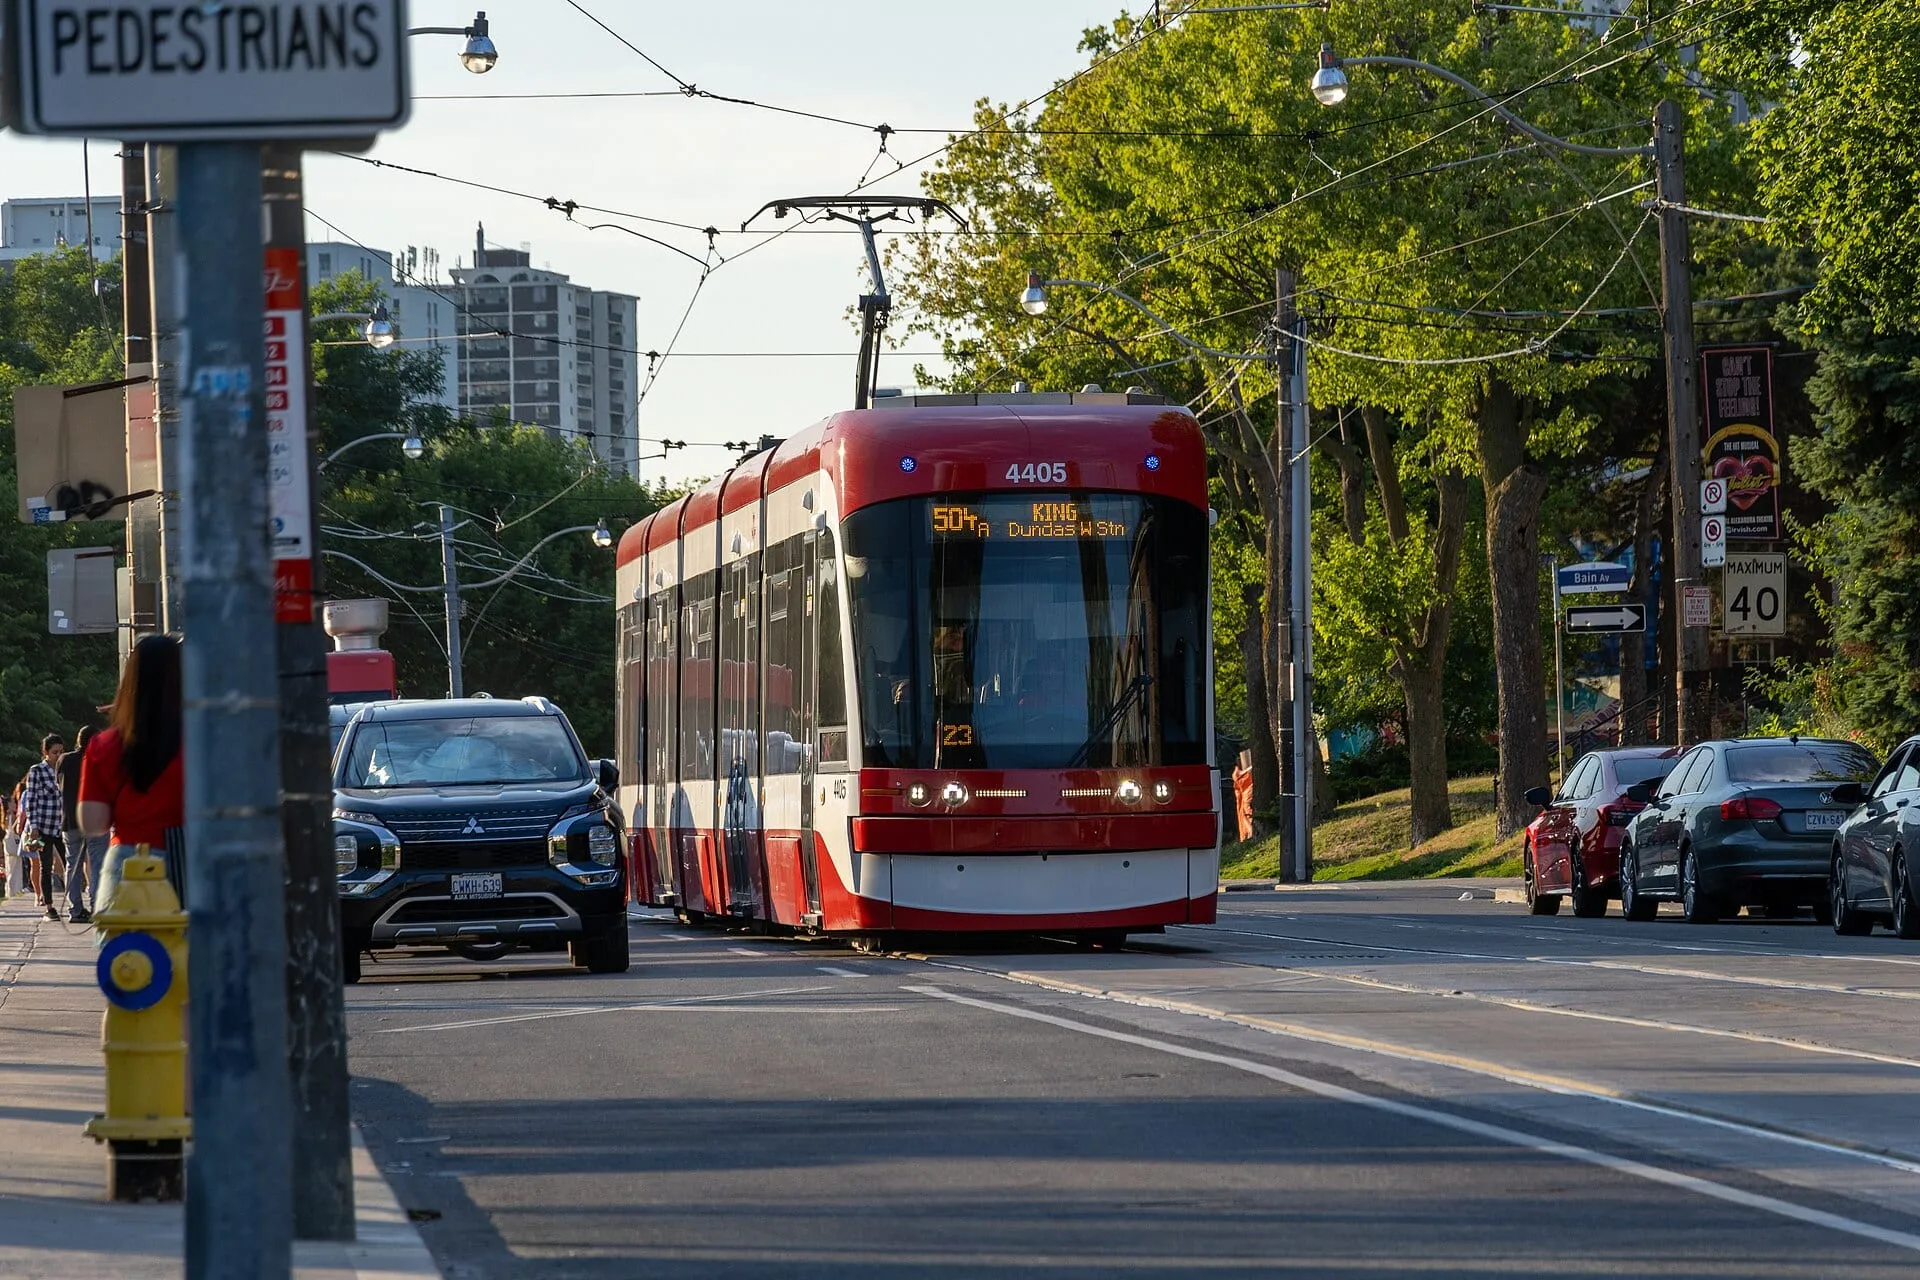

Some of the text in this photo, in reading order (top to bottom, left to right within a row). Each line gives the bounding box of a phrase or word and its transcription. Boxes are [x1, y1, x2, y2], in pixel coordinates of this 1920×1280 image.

[51, 4, 380, 76] PEDESTRIANS
[1741, 376, 1762, 396] THE
[1004, 461, 1068, 484] 4405
[1032, 503, 1077, 522] KING
[1008, 521, 1125, 537] Dundas W Stn
[1727, 561, 1783, 574] MAXIMUM
[1574, 572, 1610, 584] Bain Av
[1729, 586, 1779, 622] 40
[943, 724, 972, 746] 23
